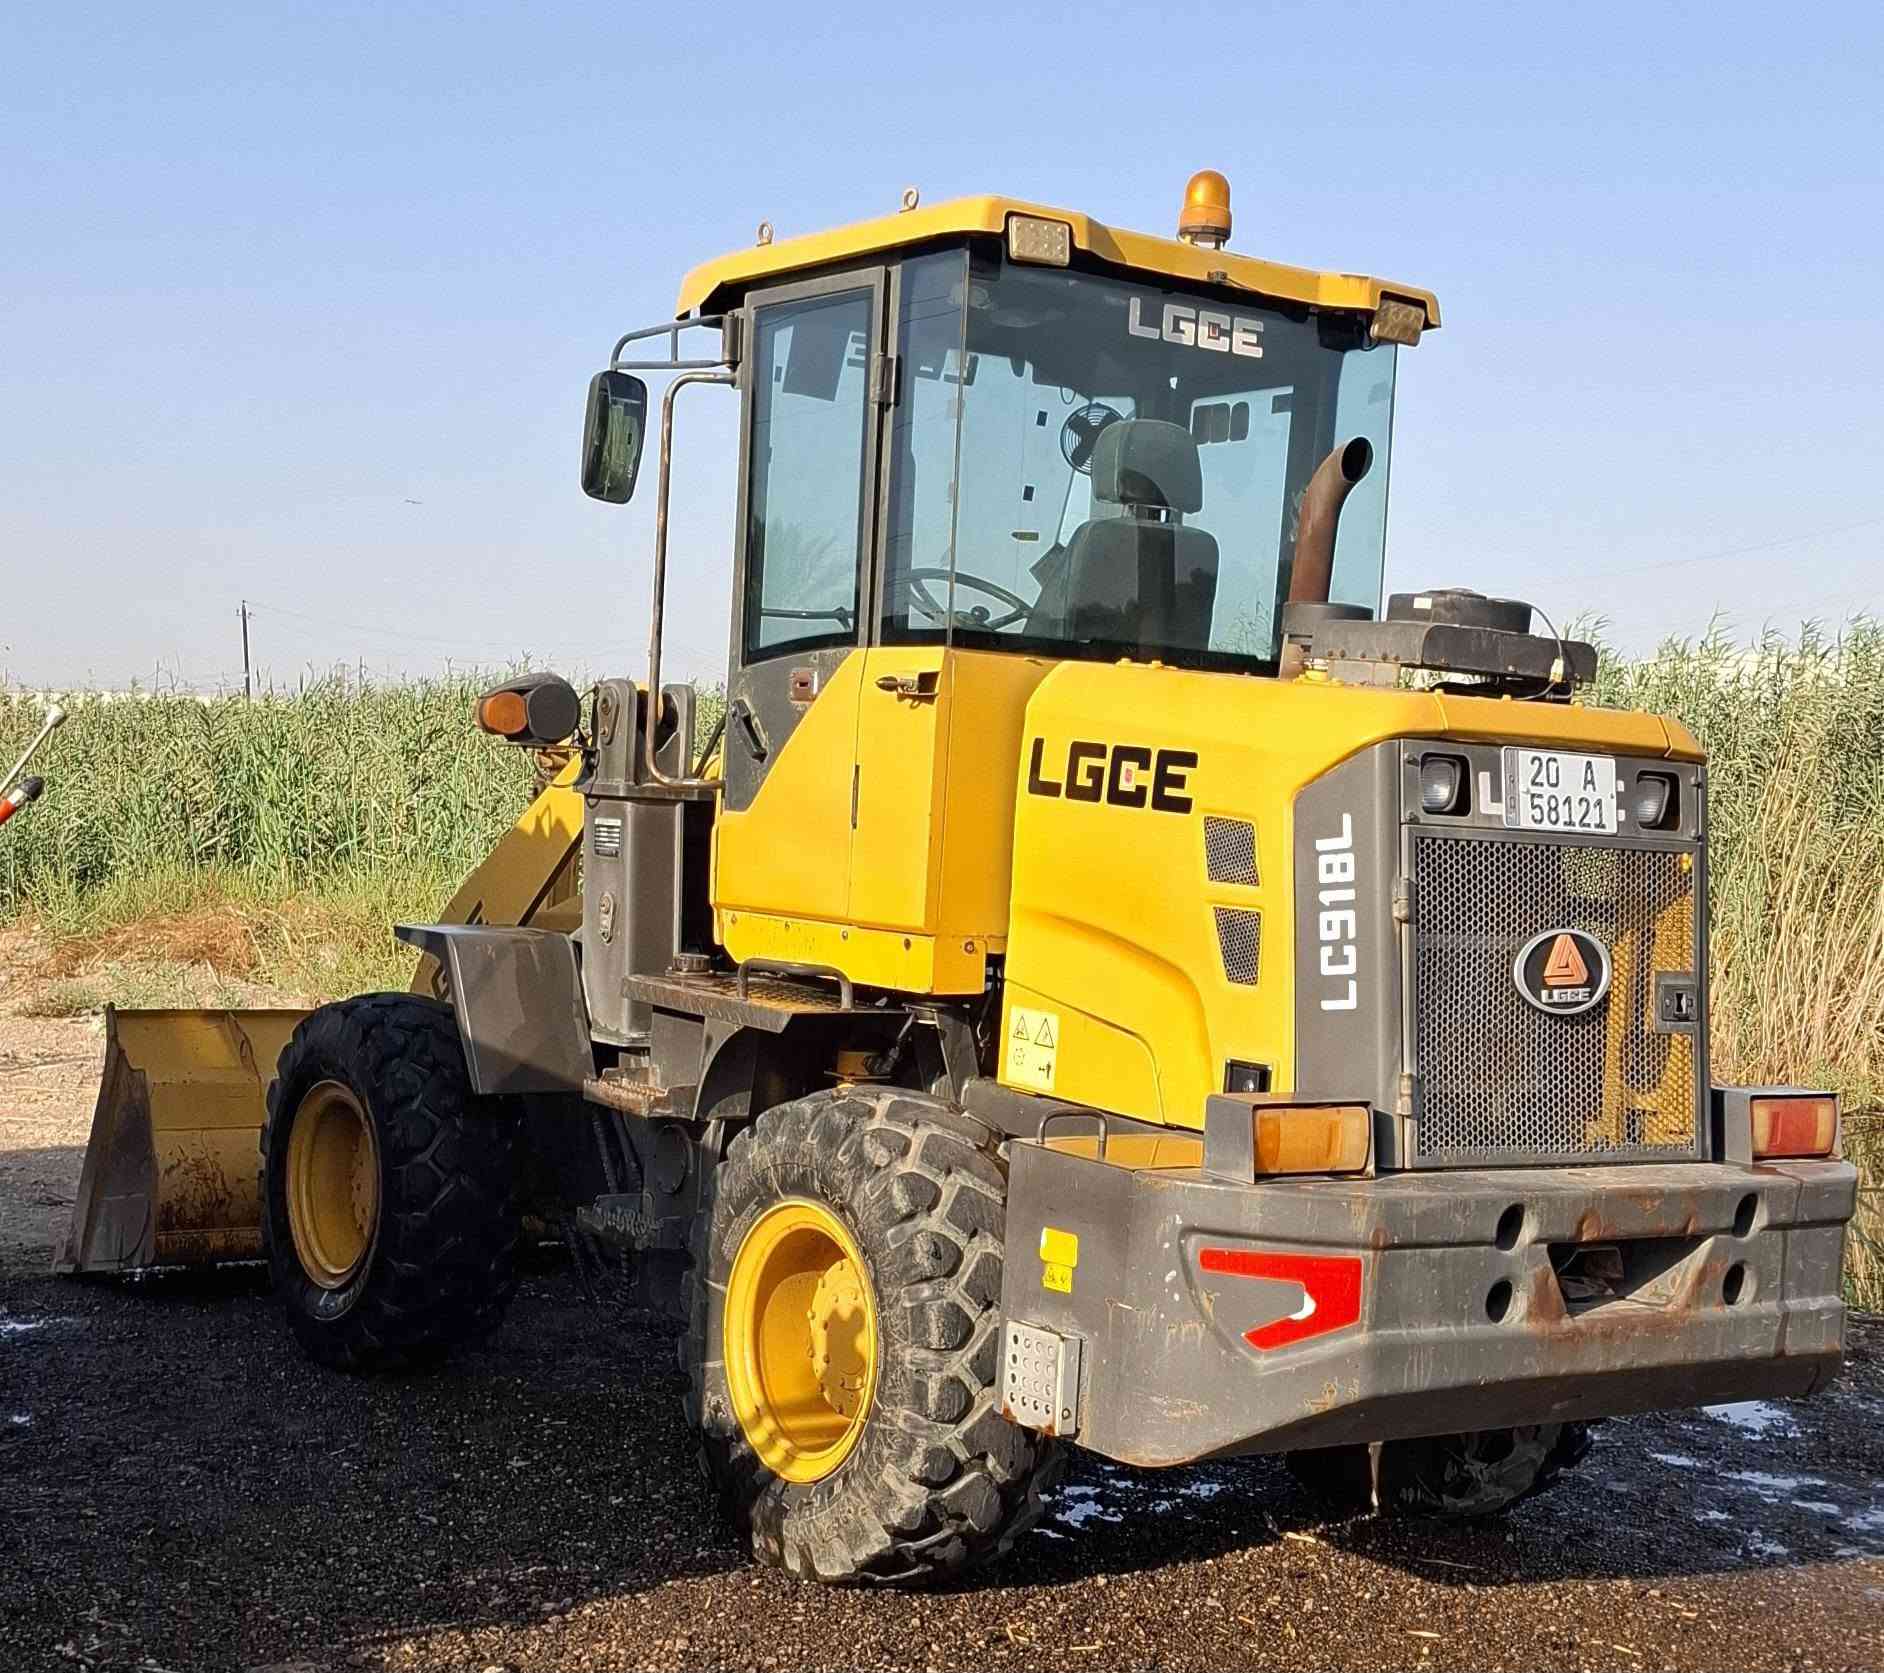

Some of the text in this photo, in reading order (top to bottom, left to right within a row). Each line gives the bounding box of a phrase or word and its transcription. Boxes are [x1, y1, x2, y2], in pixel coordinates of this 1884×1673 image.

[1128, 297, 1264, 358] LGCE
[1028, 738, 1198, 814] LGCE
[1530, 756, 1560, 788] 20
[1583, 760, 1596, 792] A
[1530, 793, 1606, 829] 58121
[1315, 812, 1357, 1010] LC918L
[1541, 988, 1591, 1003] LGCE
